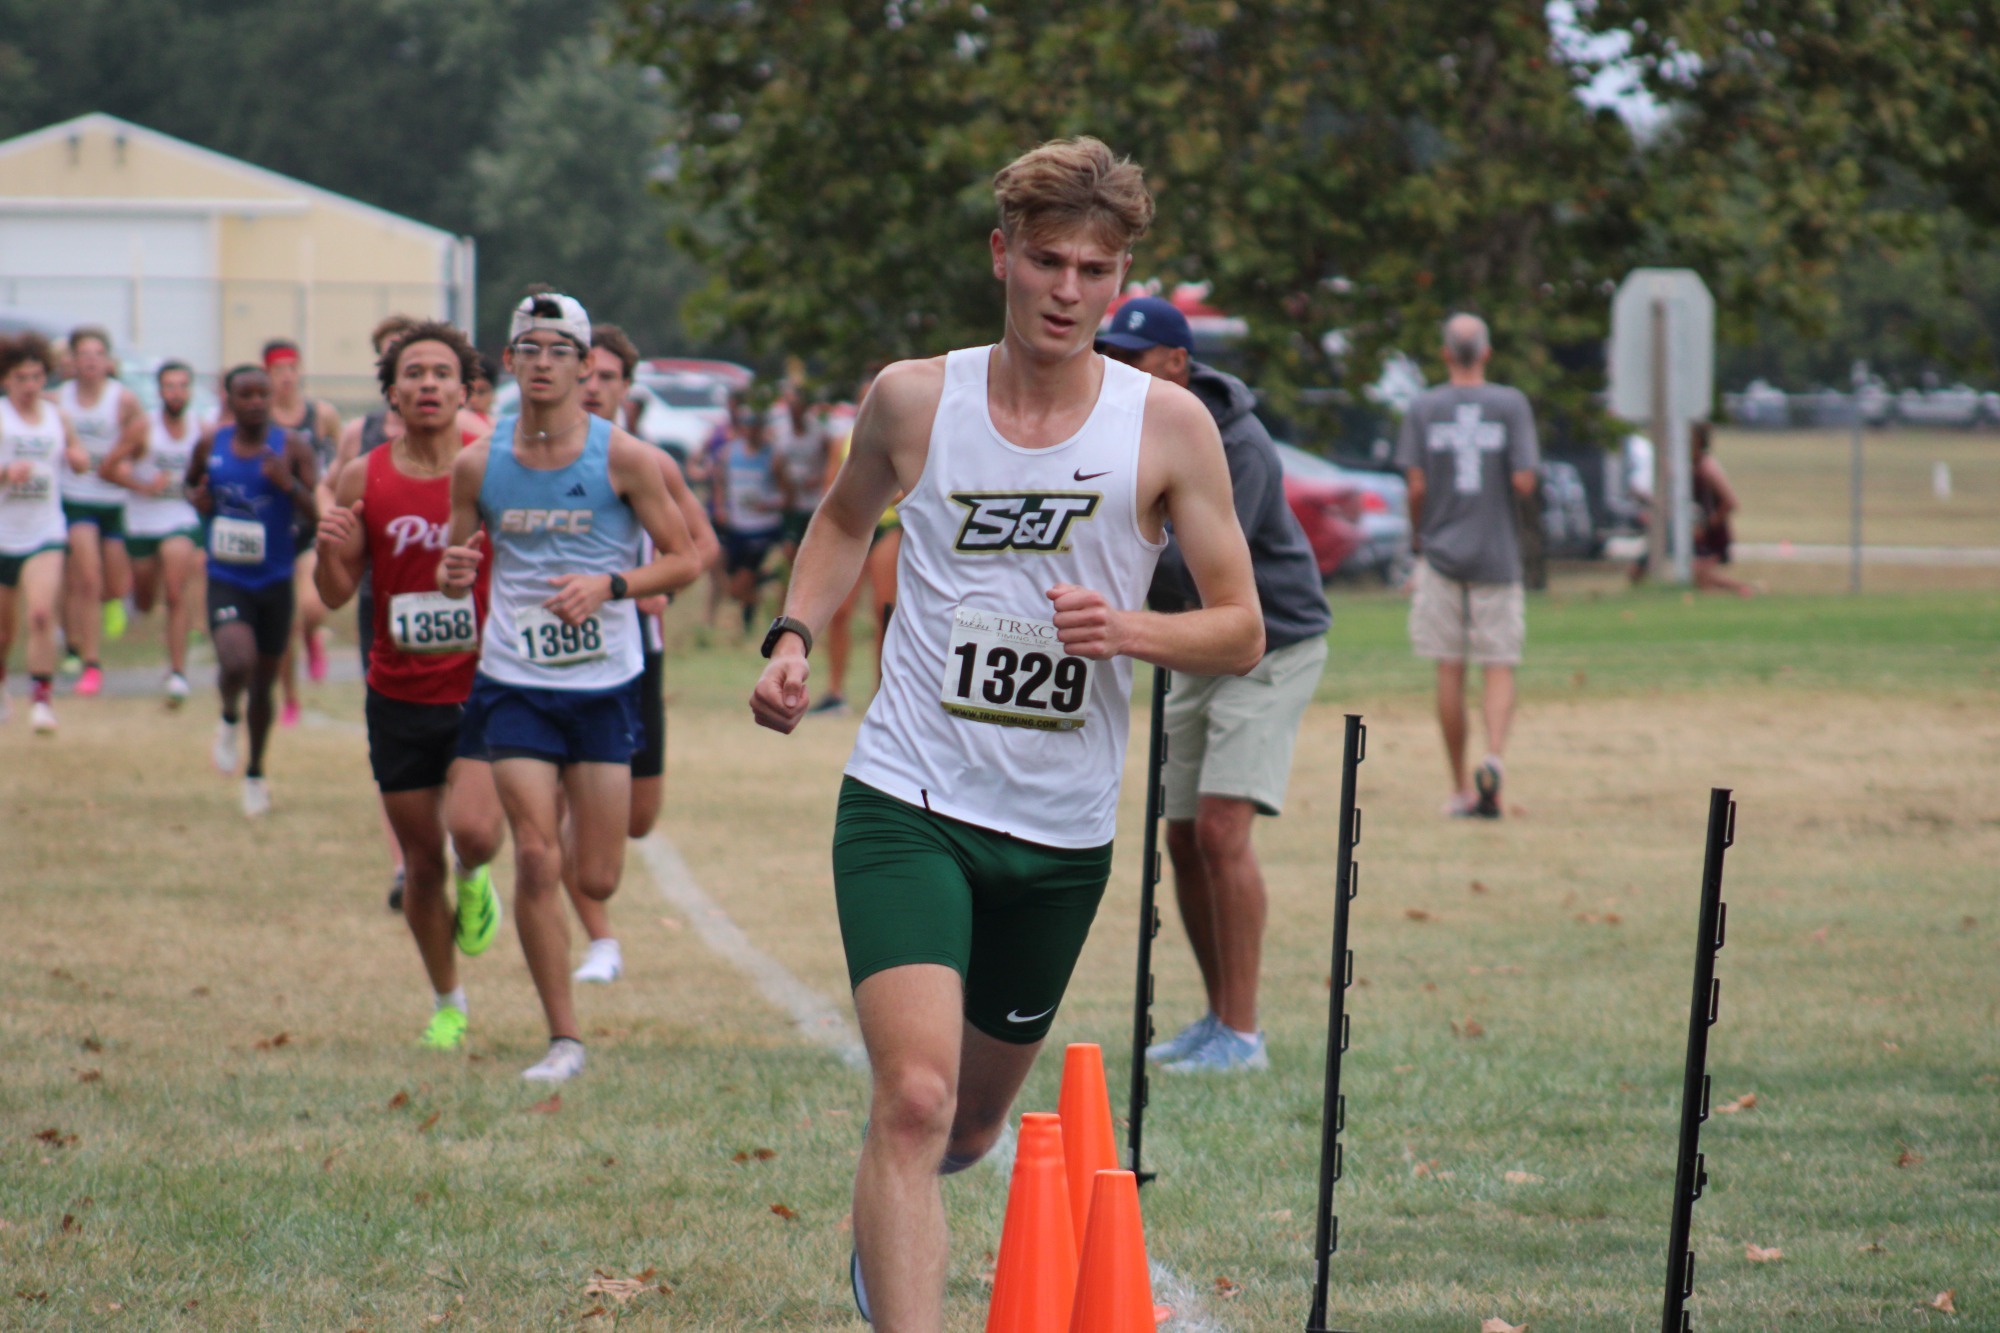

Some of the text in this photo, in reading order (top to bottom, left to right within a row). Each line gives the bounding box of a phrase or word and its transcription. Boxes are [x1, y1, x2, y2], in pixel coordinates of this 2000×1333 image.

[386, 515, 449, 556] Pit
[502, 509, 592, 534] SFCC
[950, 494, 1100, 549] S&T
[397, 609, 472, 644] 1358
[521, 617, 601, 658] 1398
[954, 641, 1087, 713] 1329
[951, 706, 1058, 729] WWW.TRXCTIMING.COM
